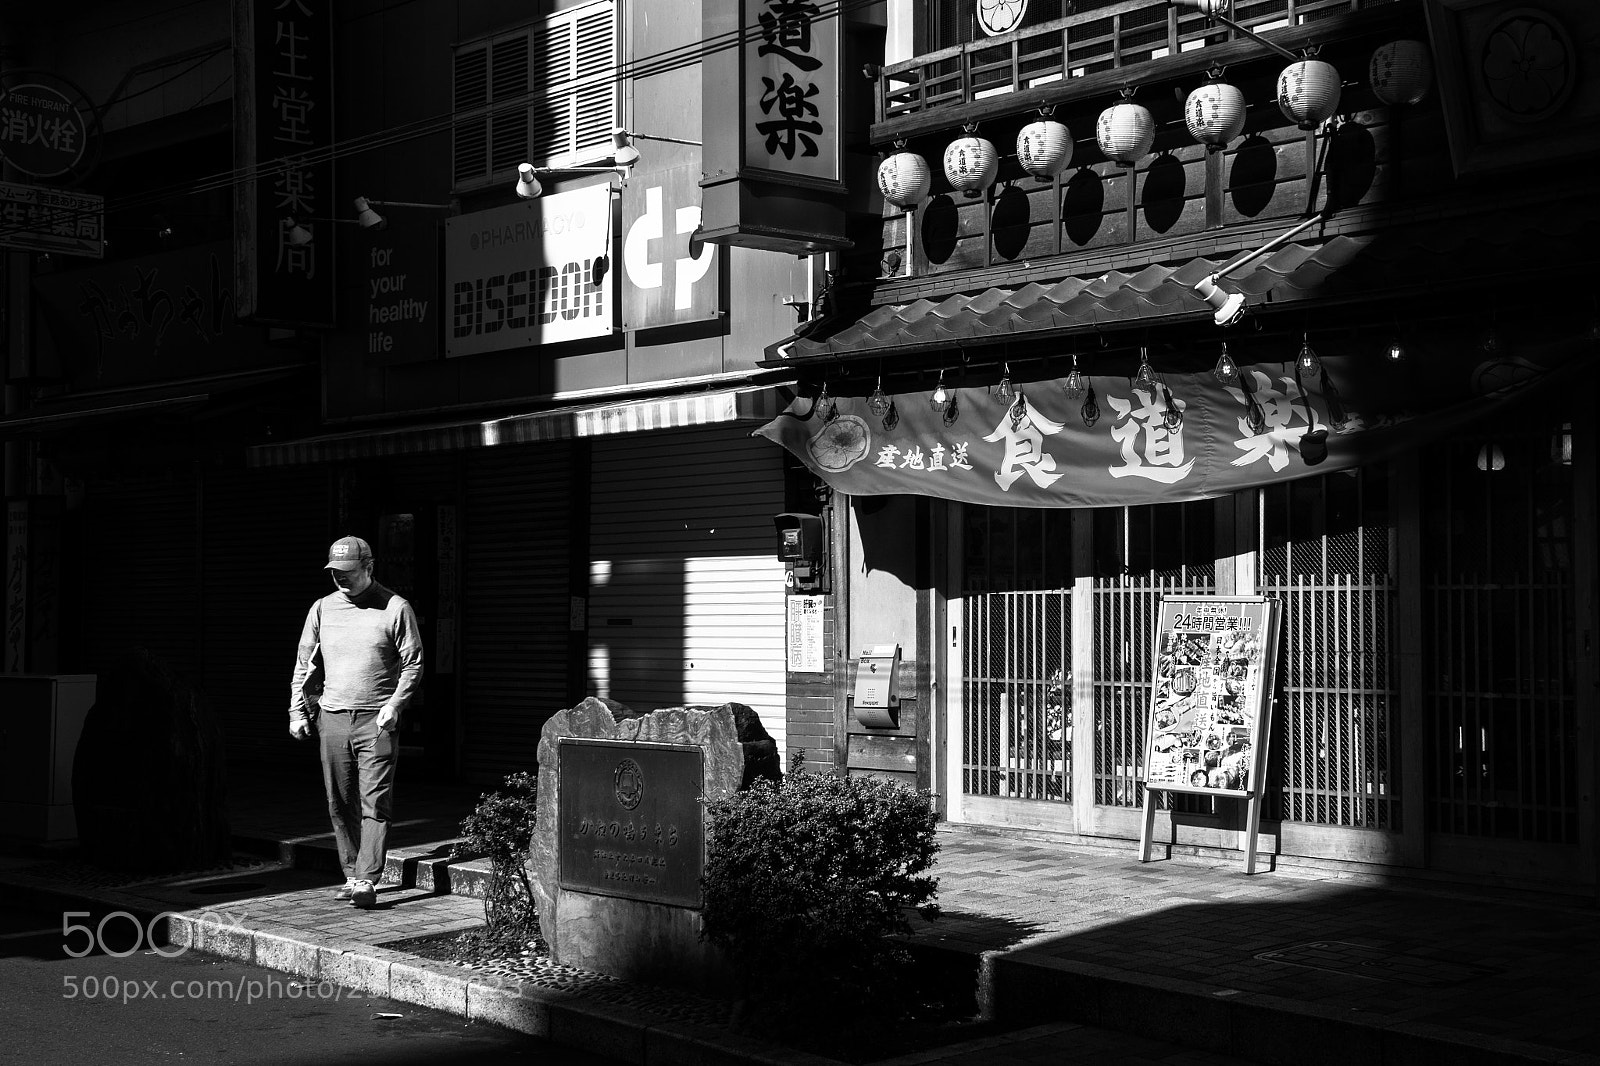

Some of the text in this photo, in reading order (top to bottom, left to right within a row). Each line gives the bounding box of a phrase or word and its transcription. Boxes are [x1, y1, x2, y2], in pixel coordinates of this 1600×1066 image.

[755, 0, 824, 161] 道楽
[9, 93, 71, 113] FIRE HYDRANT
[1, 107, 79, 153] 消火栓
[272, 0, 317, 281] 生堂薬局
[481, 213, 576, 249] PHARMACY
[370, 247, 393, 268] for
[370, 273, 407, 298] your
[368, 299, 429, 326] healthy
[368, 331, 393, 353] life
[874, 441, 973, 472] 産地直送
[1173, 613, 1252, 632] 24時間営業!!!
